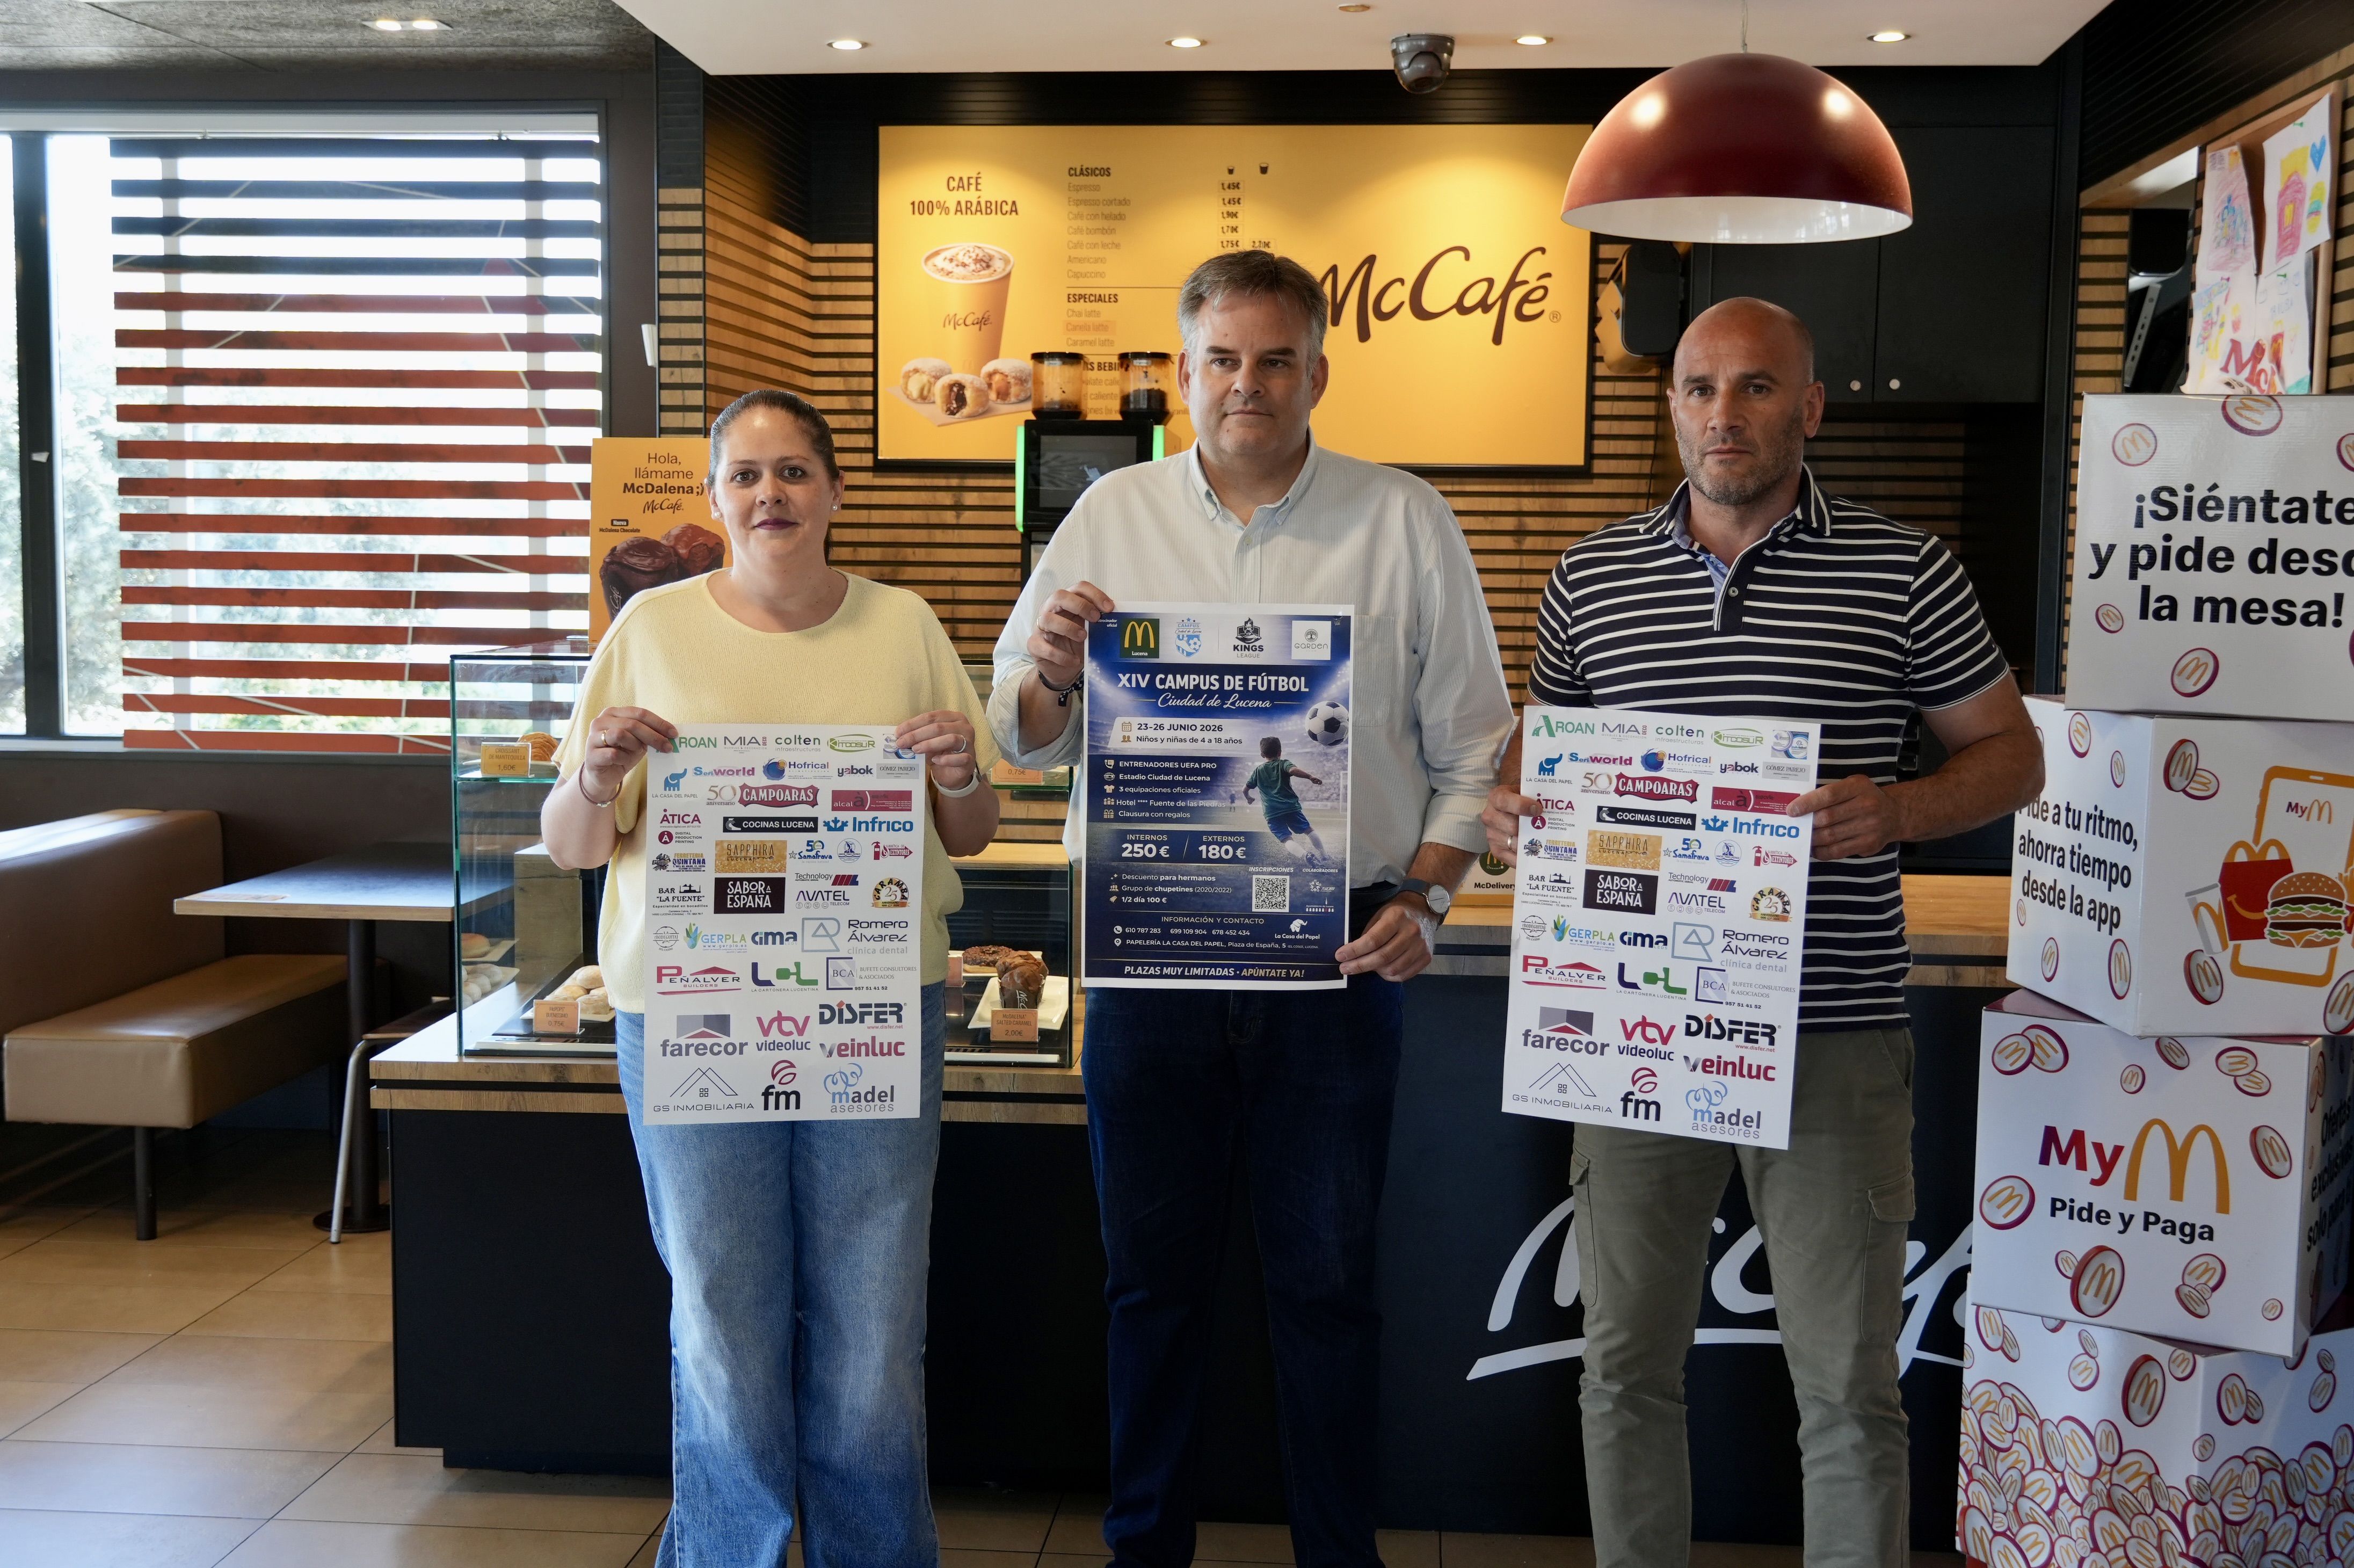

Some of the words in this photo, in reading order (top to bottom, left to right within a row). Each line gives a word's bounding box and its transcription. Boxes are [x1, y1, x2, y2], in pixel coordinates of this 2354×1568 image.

[1068, 165, 1111, 177] CLÁSICOS
[947, 172, 982, 191] CAFÉ
[1068, 183, 1100, 192] Espresso
[911, 201, 949, 215] 100%
[955, 196, 1019, 215] ARÁBICA
[1067, 294, 1118, 303] ESPECIALES
[1321, 246, 1552, 346] McCafé
[943, 311, 990, 331] McCafé
[648, 453, 681, 465] Hola,
[635, 467, 693, 479] llámame
[643, 498, 681, 514] McCafé
[2134, 482, 2354, 528] ¡Siéntate
[2088, 542, 2117, 579] y
[2128, 533, 2234, 580] pide
[2139, 585, 2177, 621] la
[2193, 592, 2344, 628] mesa!
[1117, 674, 1150, 687] XIV
[1156, 674, 1219, 690] CAMPUS
[1224, 676, 1244, 691] DE
[1248, 673, 1309, 692] FÚTBOL
[1158, 693, 1204, 707] Ciudad
[1207, 696, 1220, 707] de
[1223, 693, 1272, 708] Lucena
[1656, 725, 1704, 738] colten
[724, 736, 761, 745] MIA
[775, 735, 820, 745] colten
[1668, 753, 1711, 764] Hofrical
[838, 765, 873, 777] yabok
[1720, 762, 1759, 774] yabok
[743, 789, 813, 802] CAMPOARAS
[1618, 779, 1692, 797] CAMPOARAS
[743, 821, 780, 829] COCINAS
[853, 816, 913, 832] Infrico
[1617, 812, 1655, 823] COCINAS
[1657, 816, 1692, 825] LUCENA
[2019, 798, 2049, 822] ide
[2052, 808, 2060, 826] a
[2065, 801, 2081, 832] tu
[2085, 805, 2138, 852] ritmo,
[1733, 817, 1799, 838] Infrico
[727, 844, 774, 856] SAPPHIRA
[1599, 835, 1648, 851] SAPPHIRA
[1122, 844, 1157, 858] 250
[1159, 846, 1169, 857] €
[1198, 845, 1233, 859] 180
[1236, 847, 1246, 858] €
[2018, 830, 2065, 869] ahorra
[2070, 846, 2132, 892] tiempo
[1668, 873, 1709, 883] Technology
[727, 881, 765, 894] SABOR
[727, 895, 772, 908] ESPAÑA
[796, 890, 849, 901] AVATEL
[1596, 890, 1642, 907] ESPAÑA
[1668, 892, 1725, 908] AVATEL
[2022, 870, 2066, 911] desde
[2070, 885, 2083, 917] la
[2087, 898, 2120, 935] app
[848, 920, 908, 928] Romero
[701, 934, 746, 943] GERPLA
[752, 931, 797, 945] cima
[848, 930, 907, 942] Álvarez
[1619, 932, 1667, 948] cima
[1723, 930, 1789, 945] Romero
[1721, 941, 1787, 959] Álvarez
[1124, 966, 1160, 975] PLAZAS
[1185, 968, 1234, 976] LIMITADAS
[1241, 967, 1287, 977] APÚNTATE
[1755, 984, 1795, 992] CONSULTORES
[660, 1039, 748, 1057] farecor
[756, 1040, 810, 1051] videoluc
[819, 1036, 905, 1058] veinluc
[1522, 1029, 1610, 1056] farecor
[1618, 1044, 1674, 1061] videoluc
[1683, 1056, 1775, 1081] veinluc
[761, 1085, 801, 1111] fm
[831, 1104, 893, 1113] asesores
[1621, 1091, 1660, 1121] fm
[1694, 1109, 1761, 1129] madel
[2050, 1197, 2111, 1226] Pide
[2118, 1212, 2134, 1233] y
[2142, 1211, 2214, 1244] Paga
